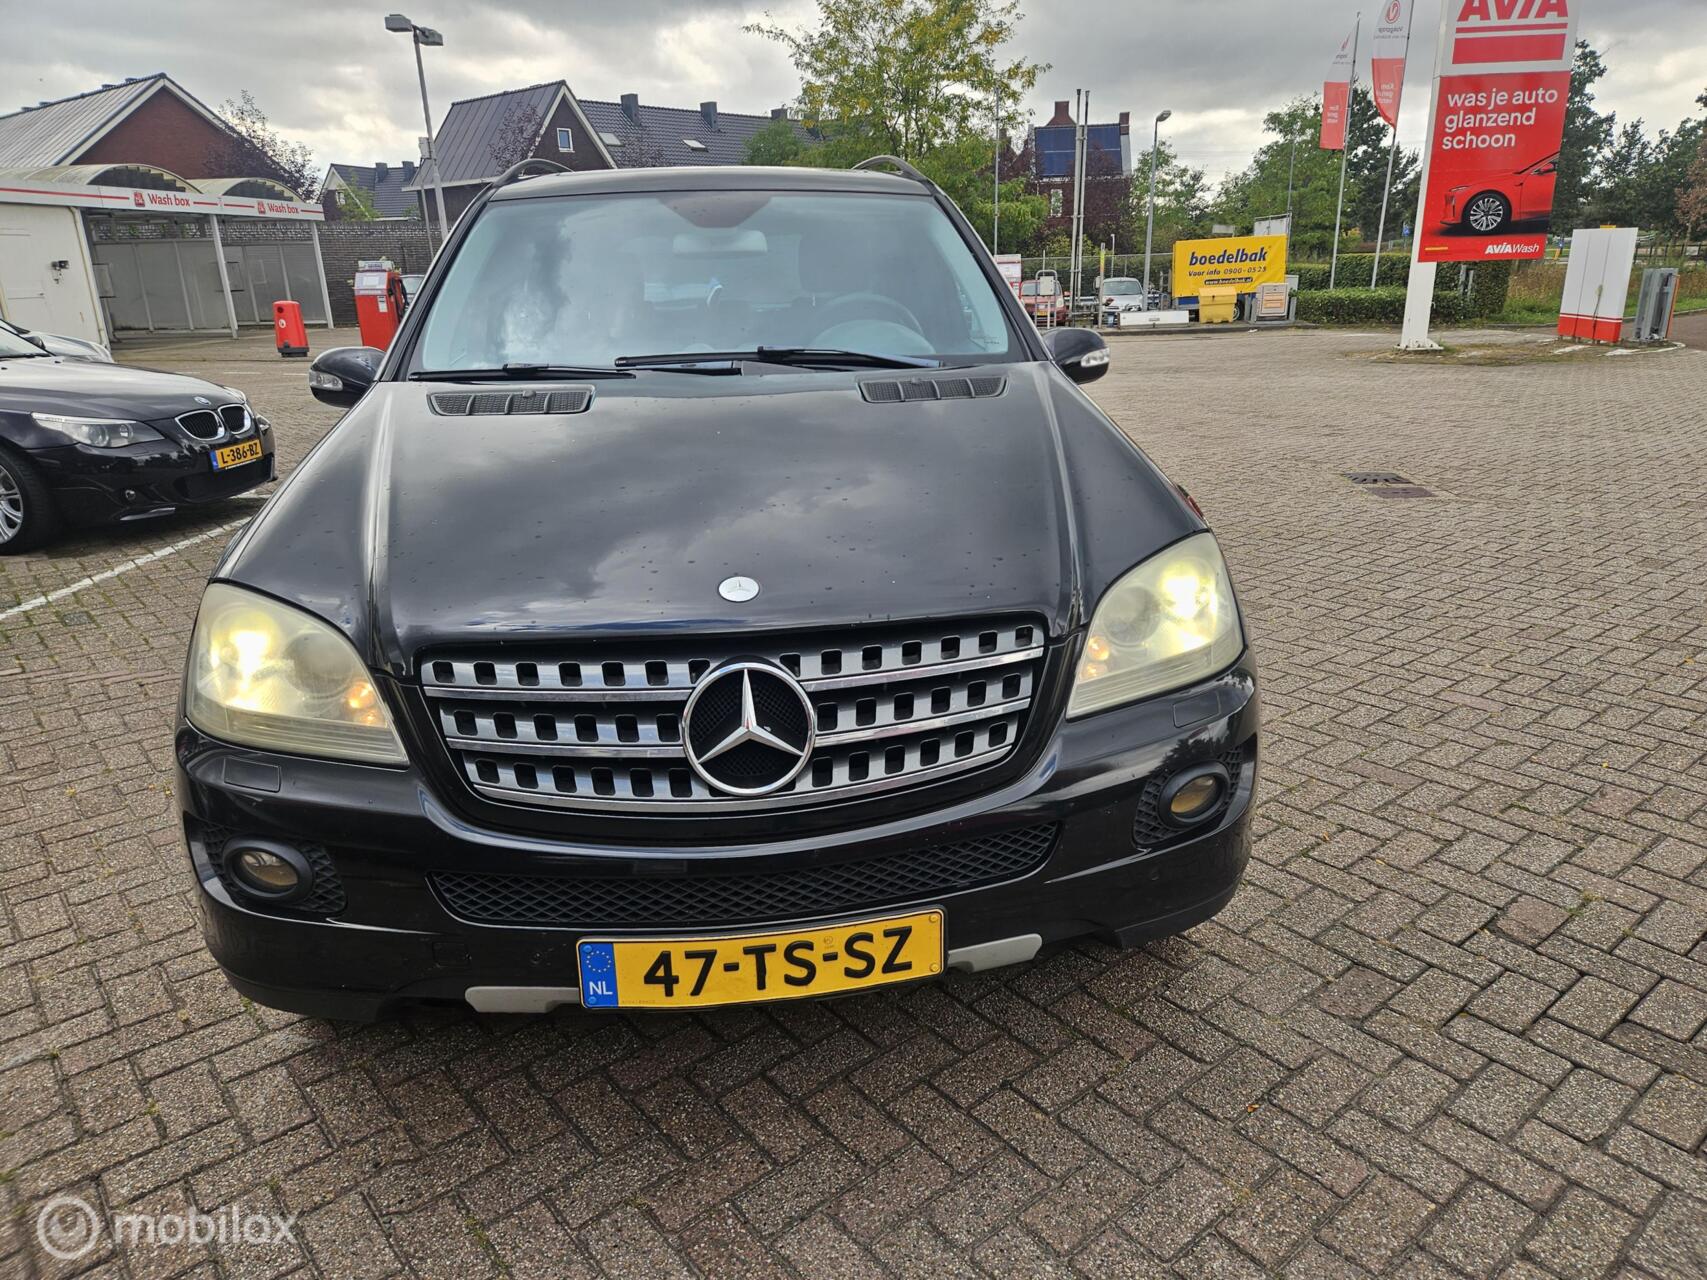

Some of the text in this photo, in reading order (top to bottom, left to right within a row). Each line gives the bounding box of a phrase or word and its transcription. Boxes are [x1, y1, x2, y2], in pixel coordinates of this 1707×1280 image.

[1457, 0, 1569, 22] AVIA
[1447, 87, 1558, 110] was je auto
[1445, 108, 1536, 133] glanzend
[1442, 131, 1516, 150] schoon
[147, 193, 173, 206] Wash
[174, 194, 190, 207] box
[267, 203, 286, 214] Wash
[287, 205, 299, 215] box
[1189, 247, 1268, 266] boedelbak
[1188, 269, 1204, 277] Voor
[1207, 268, 1220, 276] info
[220, 442, 260, 465] L-386-BZ
[589, 925, 913, 998] NL 47-TS-SZ
